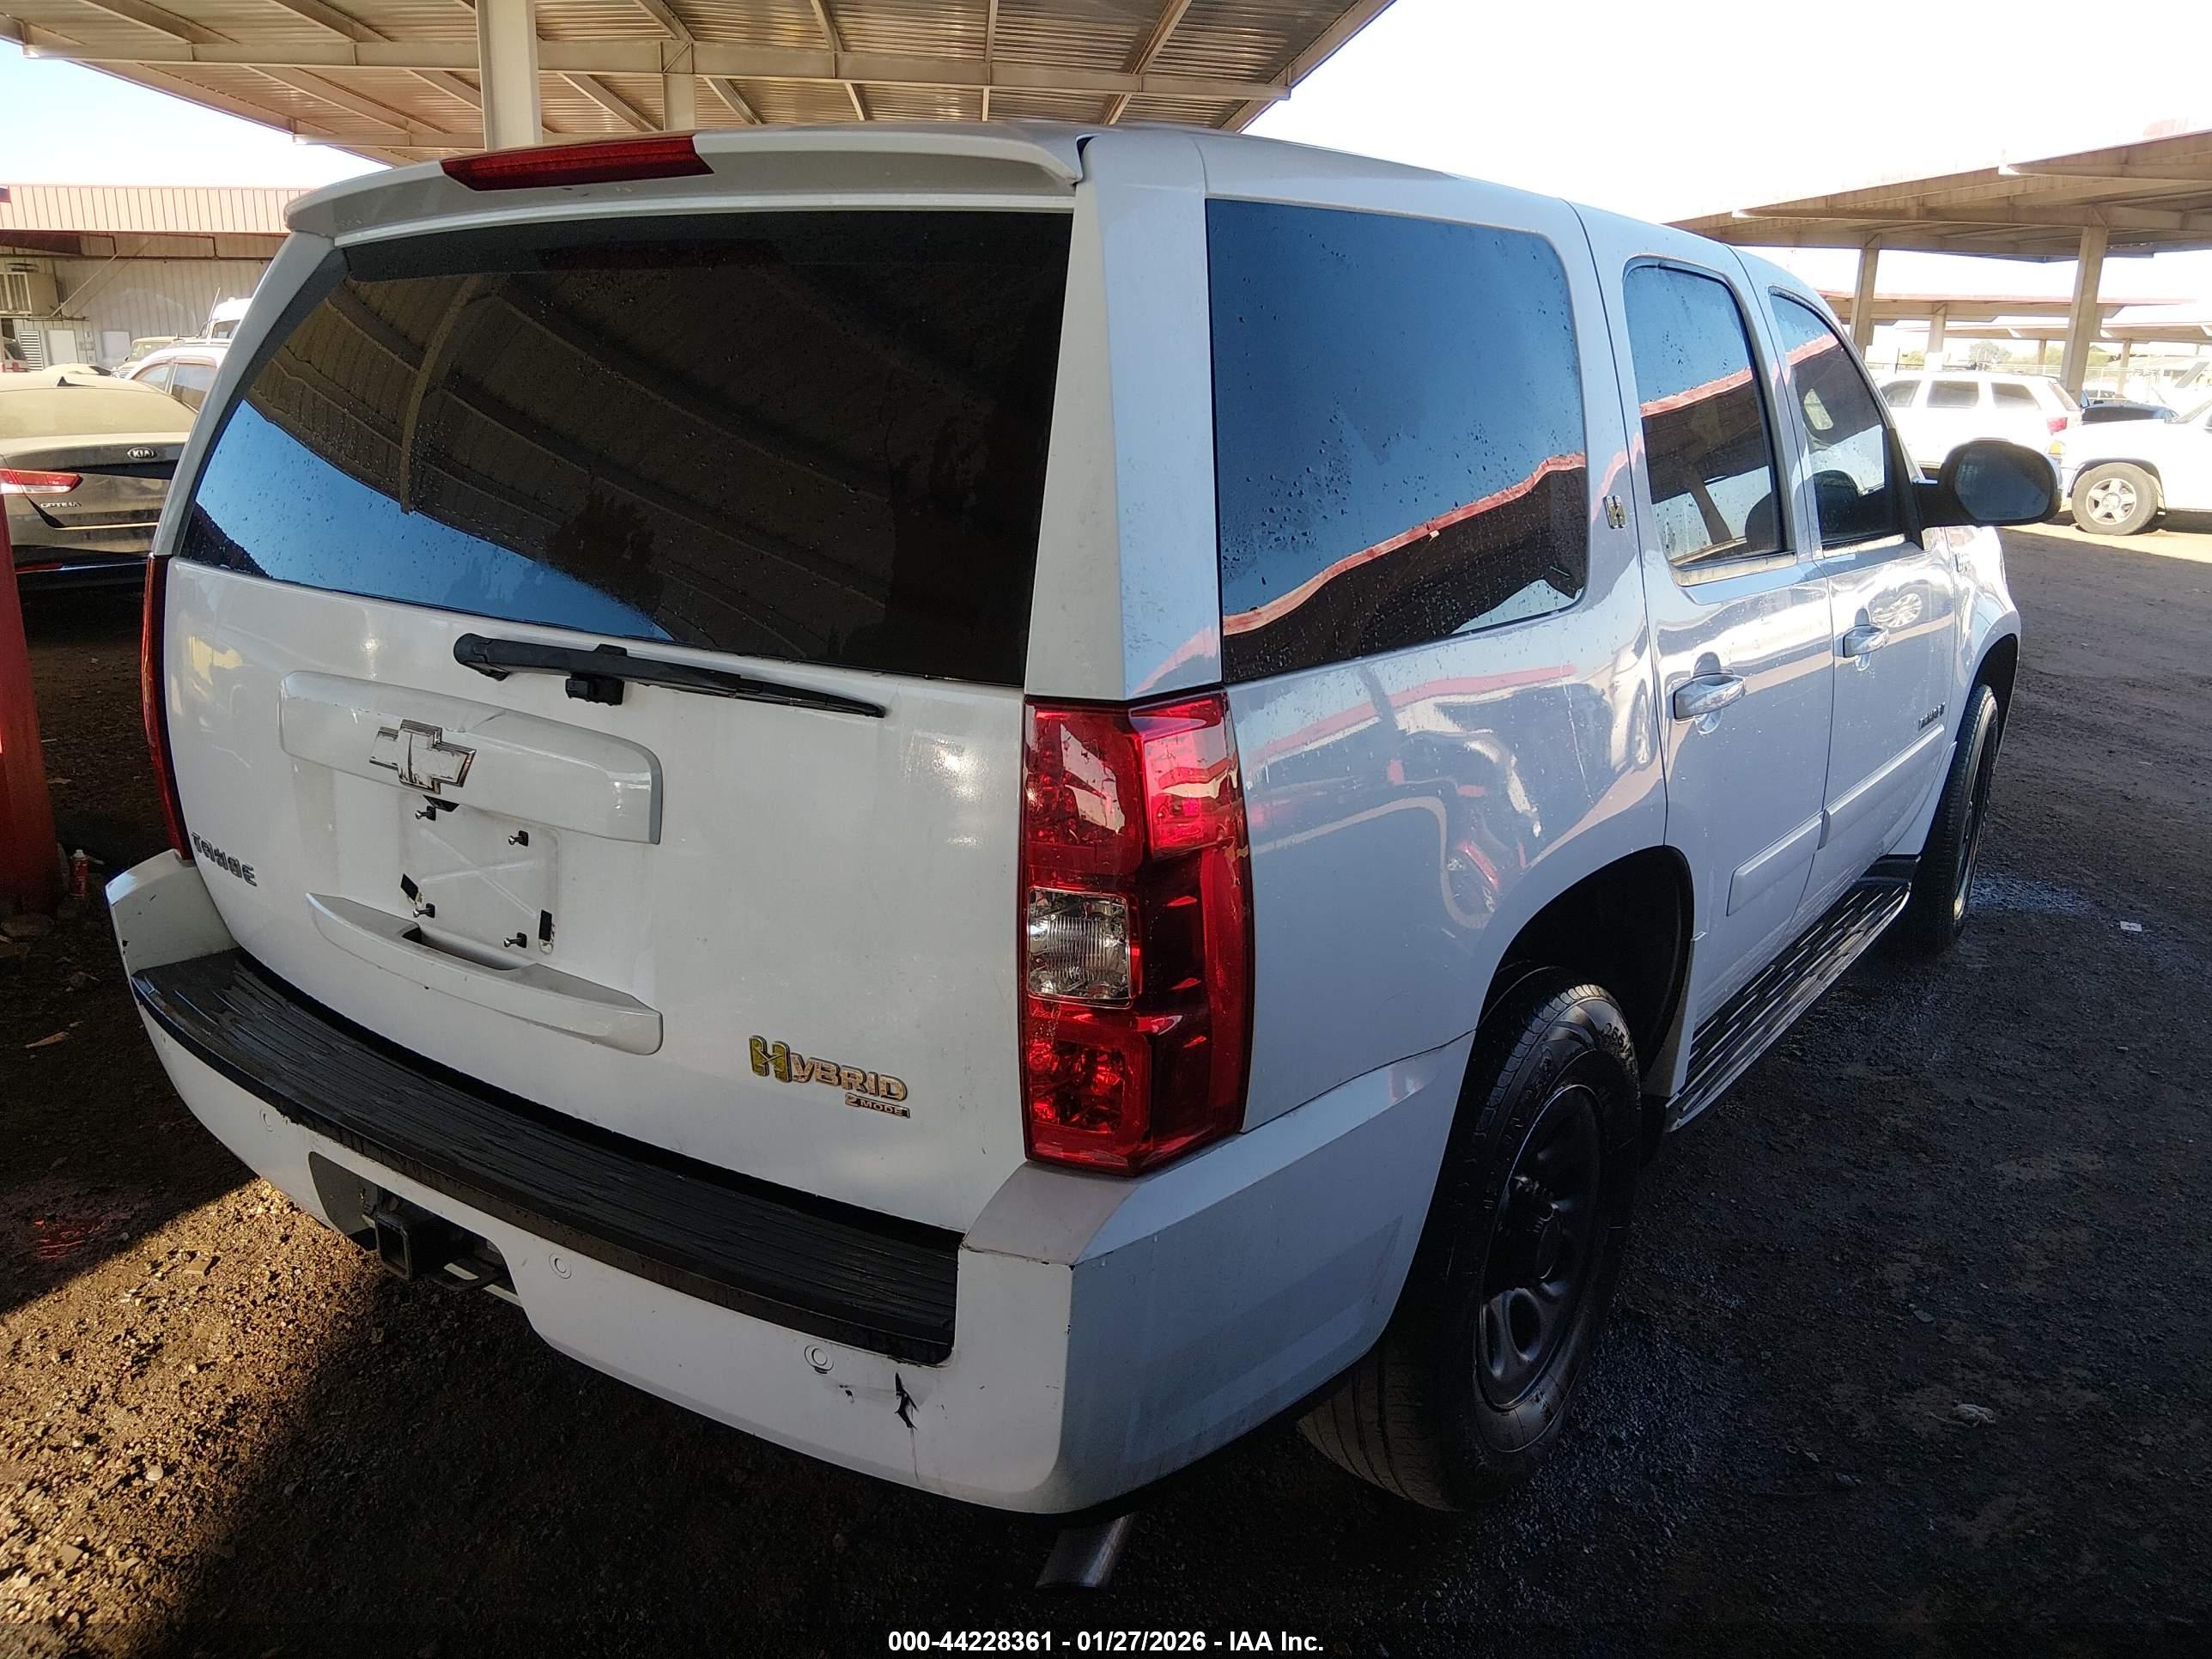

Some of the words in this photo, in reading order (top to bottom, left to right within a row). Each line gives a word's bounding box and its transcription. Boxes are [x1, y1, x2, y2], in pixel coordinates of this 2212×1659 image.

[130, 448, 153, 459] KIA
[188, 831, 258, 887] TAHOE
[749, 1035, 908, 1102] HYBRID
